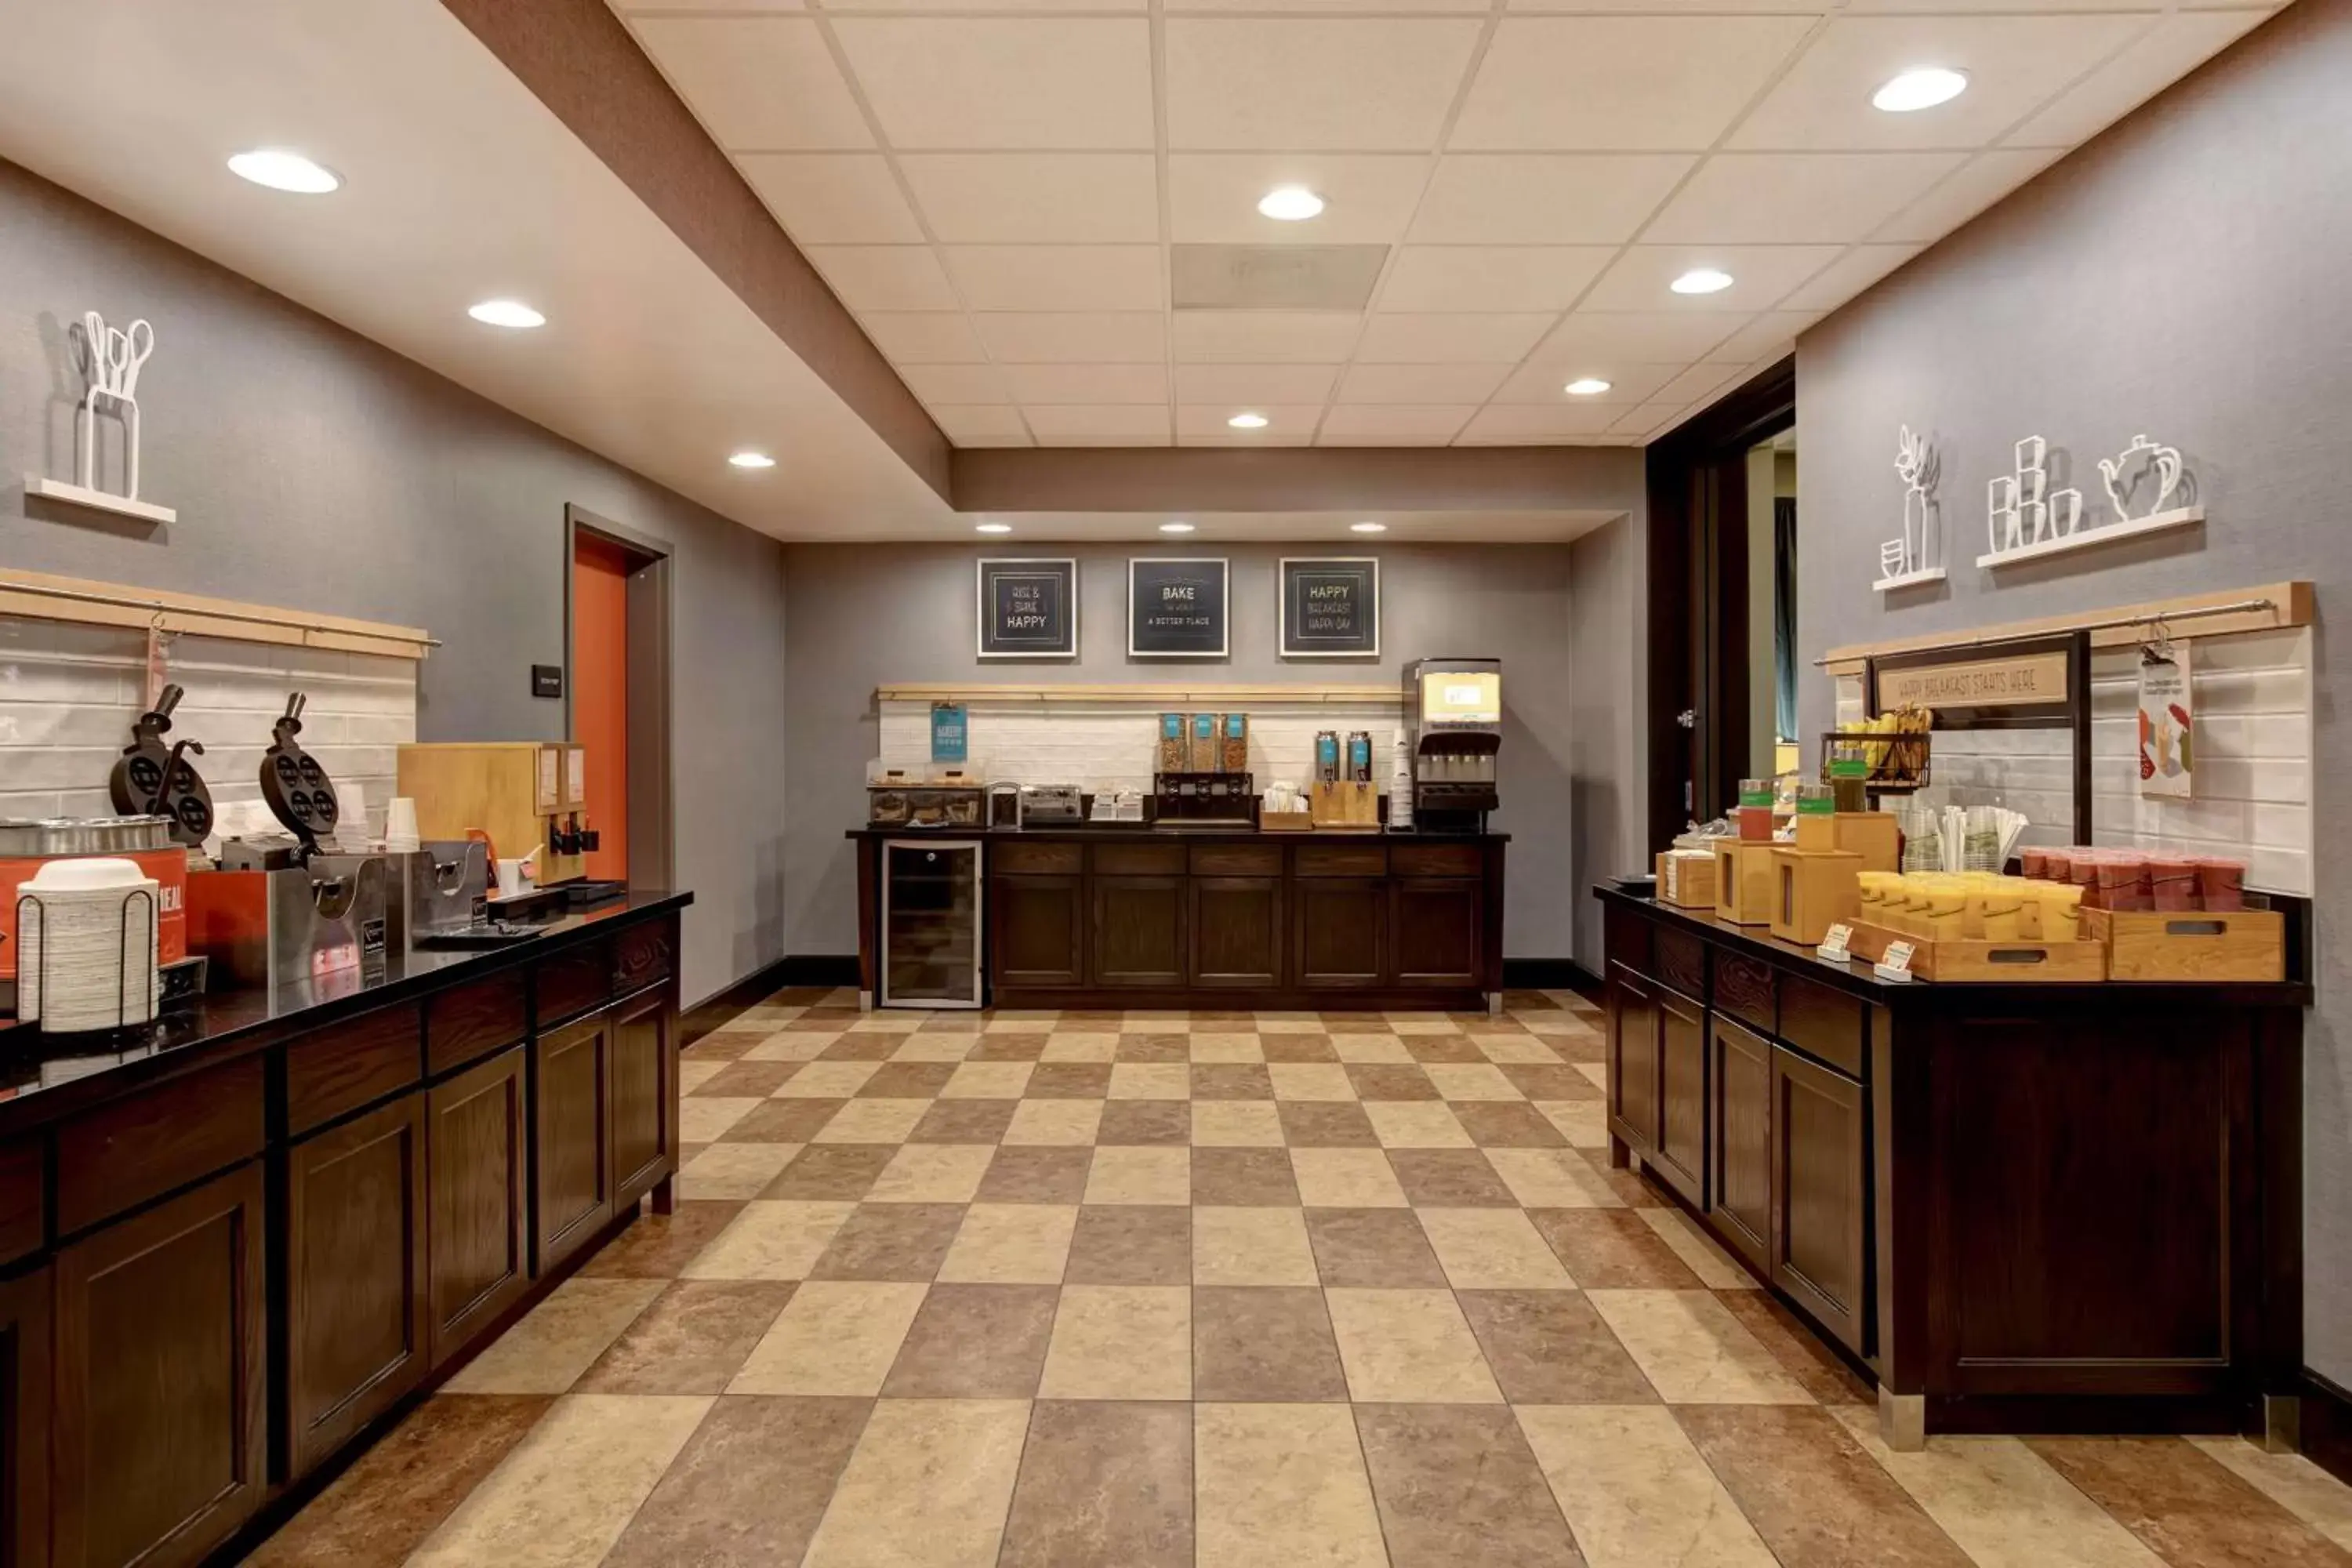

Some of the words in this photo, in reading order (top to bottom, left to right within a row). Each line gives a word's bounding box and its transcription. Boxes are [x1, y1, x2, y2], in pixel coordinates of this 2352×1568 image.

[1162, 587, 1195, 601] BAKE
[1310, 586, 1349, 599] HAPPY
[1007, 615, 1047, 628] HAPPY
[1156, 617, 1183, 626] BETTER
[1186, 617, 1210, 626] PLACE
[1925, 674, 1971, 698] BREAKFAST
[1973, 672, 2007, 695] STARTS
[2009, 669, 2037, 692] HERE
